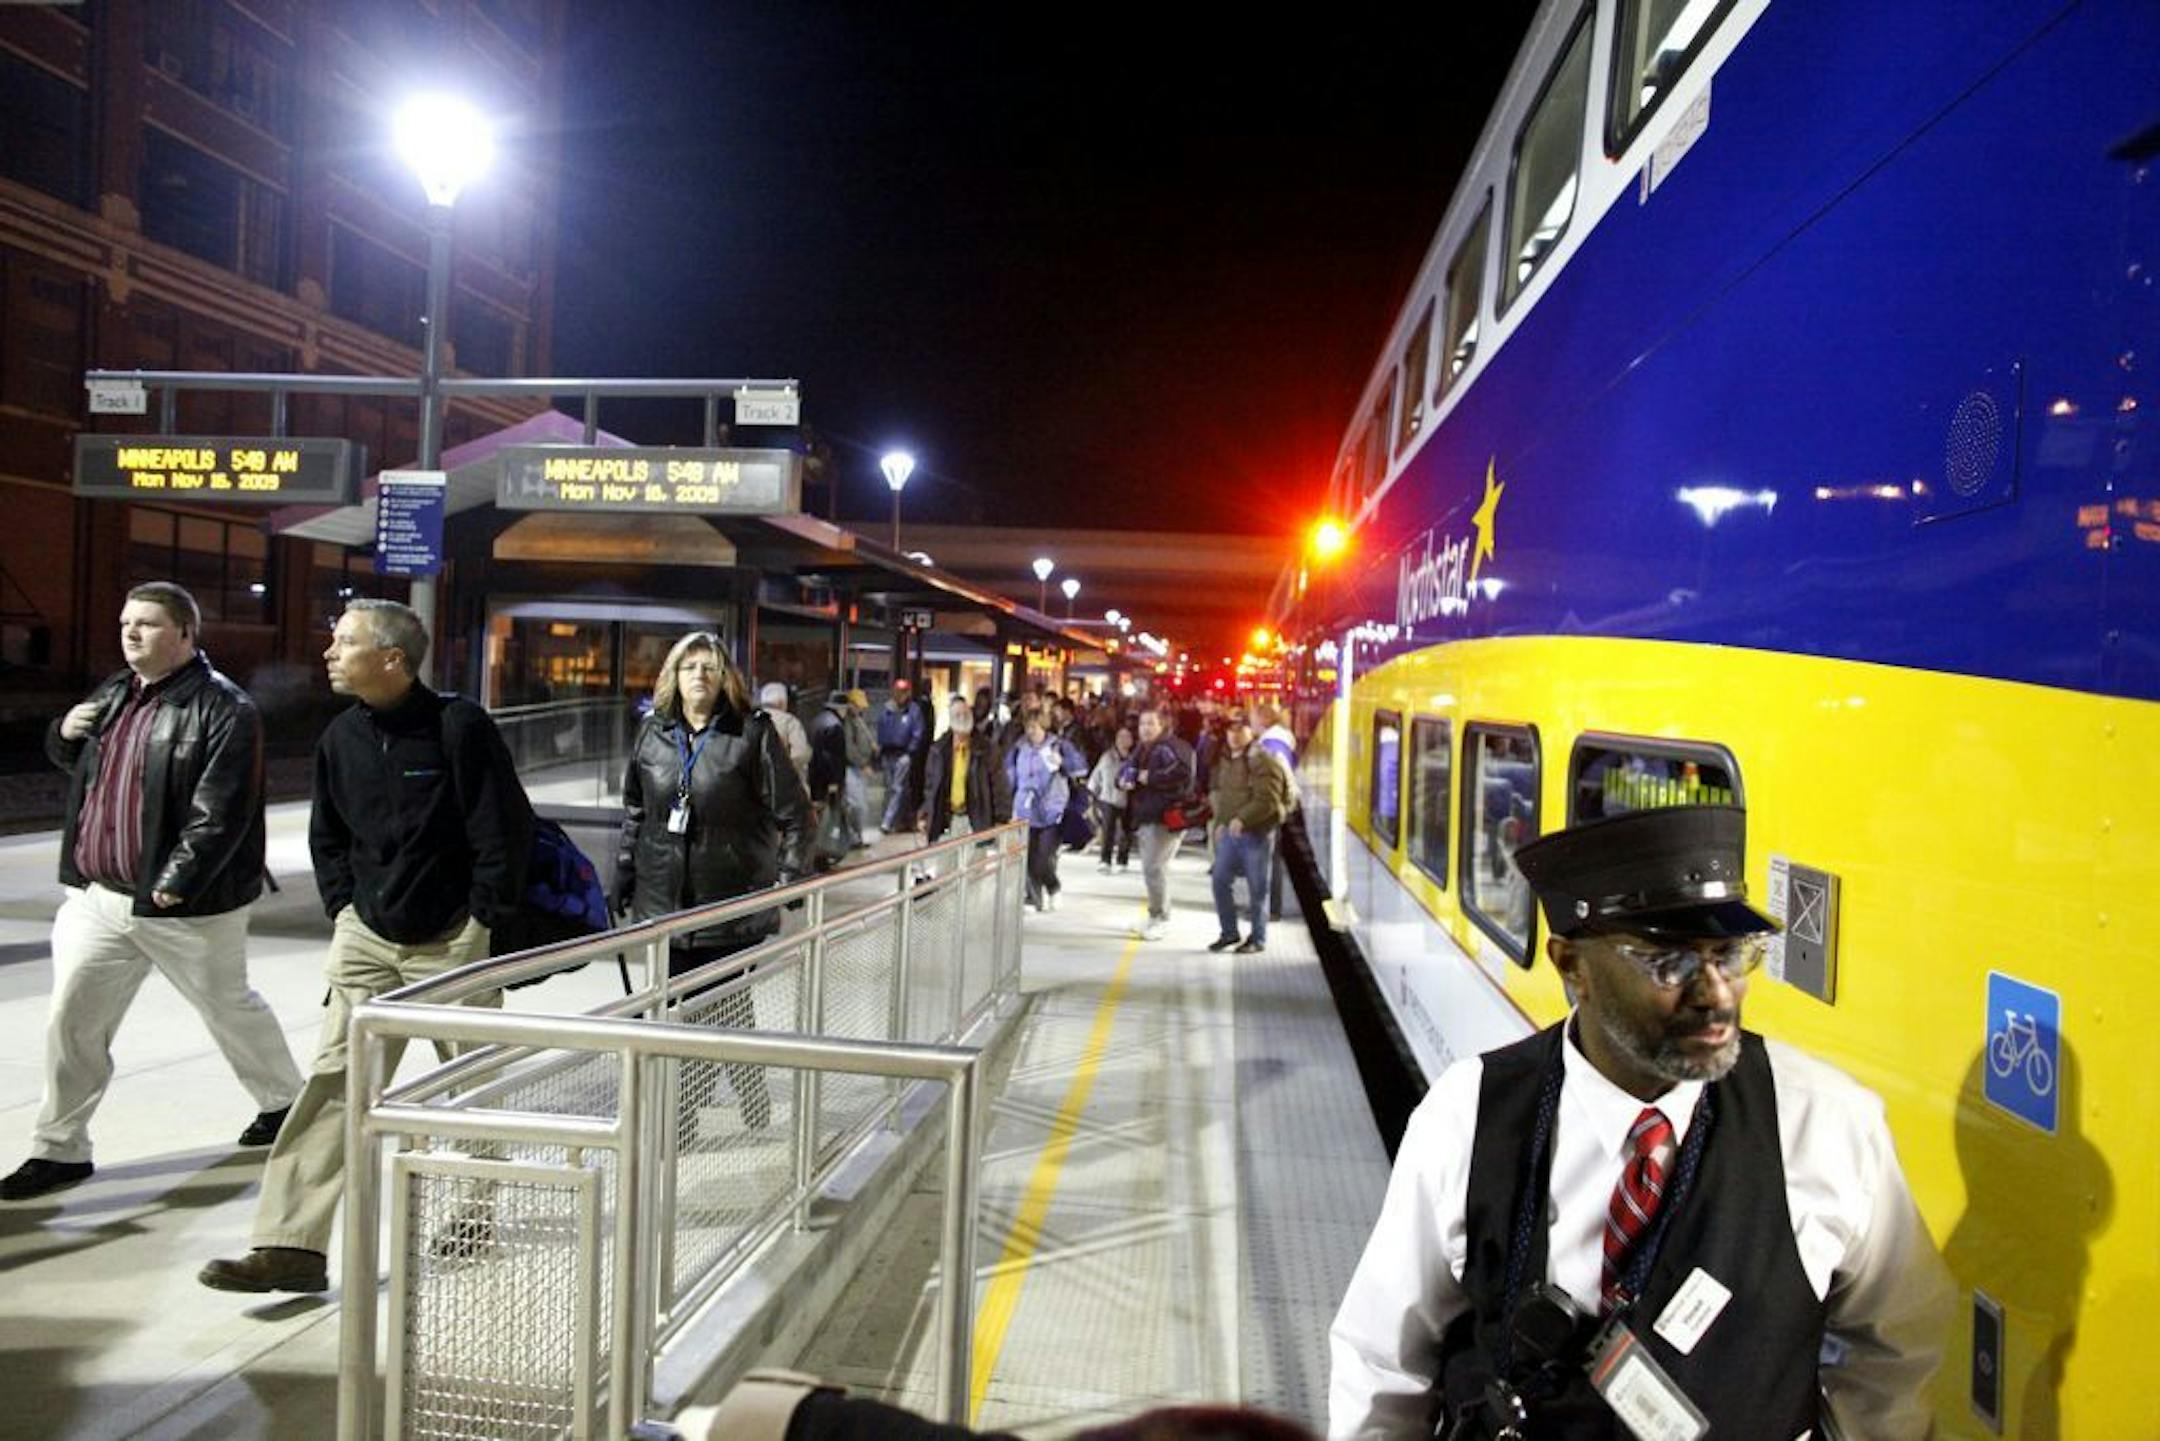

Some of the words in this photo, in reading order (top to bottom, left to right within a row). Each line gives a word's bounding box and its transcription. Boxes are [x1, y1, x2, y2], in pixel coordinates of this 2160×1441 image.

[96, 392, 129, 409] Track
[743, 404, 778, 419] Track
[784, 404, 794, 420] 2
[117, 448, 216, 471] MINNEAPOLIS
[272, 451, 299, 473] AM
[544, 458, 648, 482] MINNEAPOLIS
[713, 461, 740, 484] AM
[132, 471, 165, 488] Mon
[172, 472, 204, 489] Nov
[238, 473, 280, 491] 2009
[560, 482, 594, 500] Mon
[602, 483, 636, 501] Nov
[675, 485, 719, 504] 2009
[1397, 528, 1470, 628] Northstar
